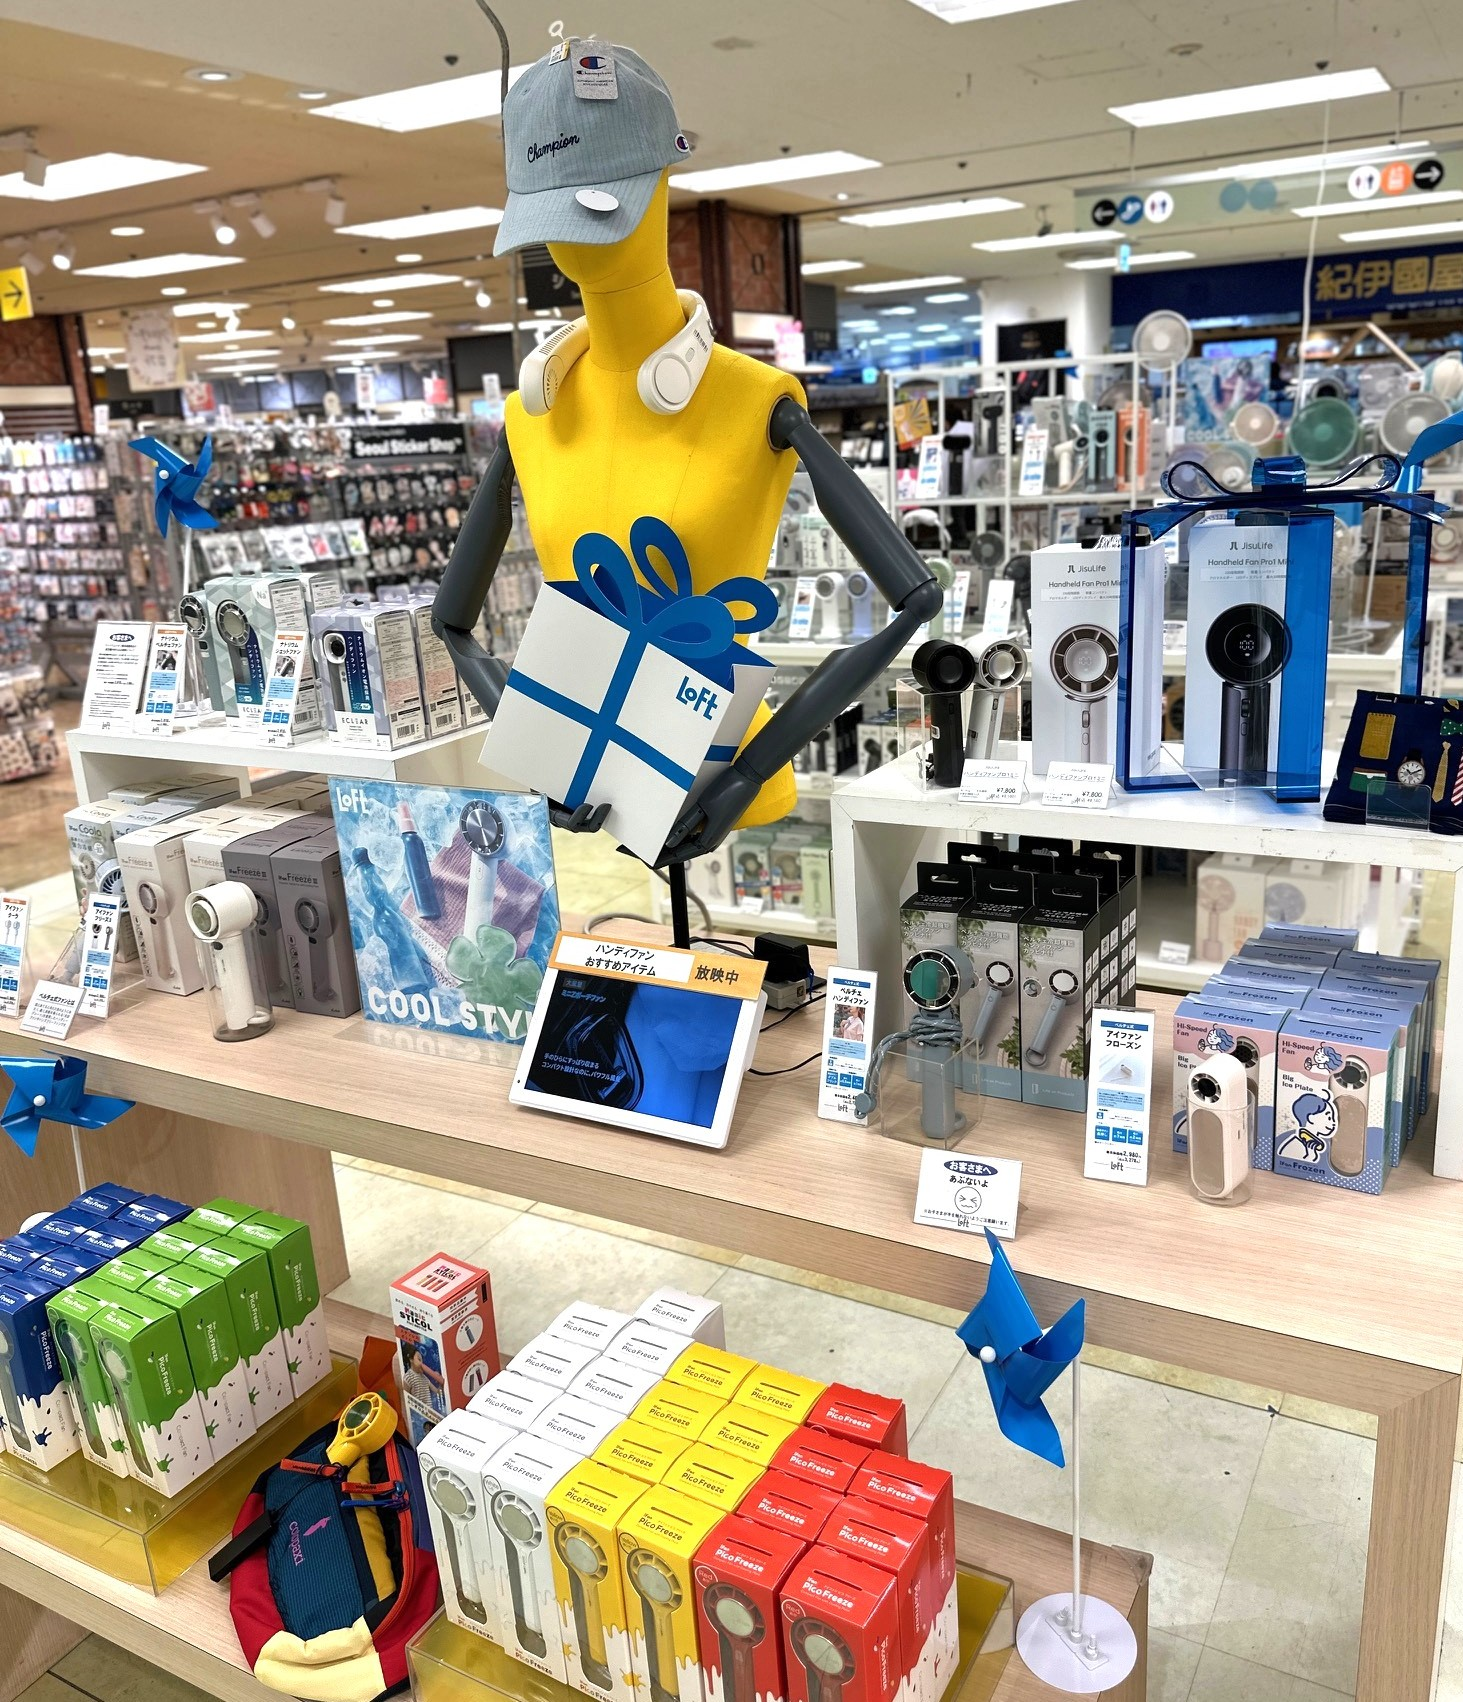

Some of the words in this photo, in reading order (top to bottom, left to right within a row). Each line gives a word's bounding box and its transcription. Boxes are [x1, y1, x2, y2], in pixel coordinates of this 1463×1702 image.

[527, 133, 580, 163] Champion
[1315, 253, 1463, 300] 紀伊國屋
[355, 441, 389, 457] Seoul
[391, 439, 429, 455] Sticker
[430, 437, 456, 454] Shop
[1241, 542, 1274, 550] JisuLife
[1078, 565, 1106, 573] JisuLife
[237, 866, 261, 877] Freeze
[287, 873, 312, 884] Freeze
[595, 944, 655, 960] ハンディファン
[584, 956, 656, 977] おすすめアイテム
[694, 964, 740, 986] 放映中
[1261, 972, 1296, 980] Frozen
[840, 987, 862, 997] ペルチェ
[1241, 991, 1278, 1001] Frozen
[1361, 986, 1398, 995] Frozen
[367, 986, 451, 1027] COOL
[832, 995, 869, 1006] ハンディファン
[1217, 1012, 1254, 1023] Frozen
[1345, 1008, 1383, 1018] Frozen
[1176, 1023, 1208, 1033] Hi-Speed
[1176, 1029, 1189, 1037] Fan
[1106, 1030, 1142, 1040] アイファン
[1325, 1030, 1363, 1041] Frozen
[1106, 1040, 1142, 1050] フローズン
[1282, 1040, 1315, 1051] Hi-Speed
[1178, 1055, 1189, 1063] Big
[1282, 1074, 1295, 1082] Big
[1294, 1083, 1314, 1093] Plate
[949, 1160, 992, 1175] お客さまへ
[1293, 1162, 1326, 1175] Frozen
[949, 1175, 989, 1188] あぶないよ
[399, 1311, 433, 1332] STICOL
[698, 1373, 723, 1386] Freeze
[767, 1396, 793, 1409] Freeze
[665, 1413, 691, 1427] Freeze
[843, 1415, 871, 1430] Freeze
[734, 1435, 760, 1450] Freeze
[627, 1454, 654, 1468] Freeze
[807, 1461, 835, 1477] Freeze
[699, 1478, 725, 1494] Freeze
[887, 1486, 916, 1502] Freeze
[581, 1497, 607, 1513] Freeze
[776, 1509, 805, 1525] Freeze
[655, 1524, 683, 1541] Freeze
[858, 1536, 889, 1553] Freeze
[733, 1555, 764, 1573] Freeze
[822, 1590, 853, 1608] Freeze
